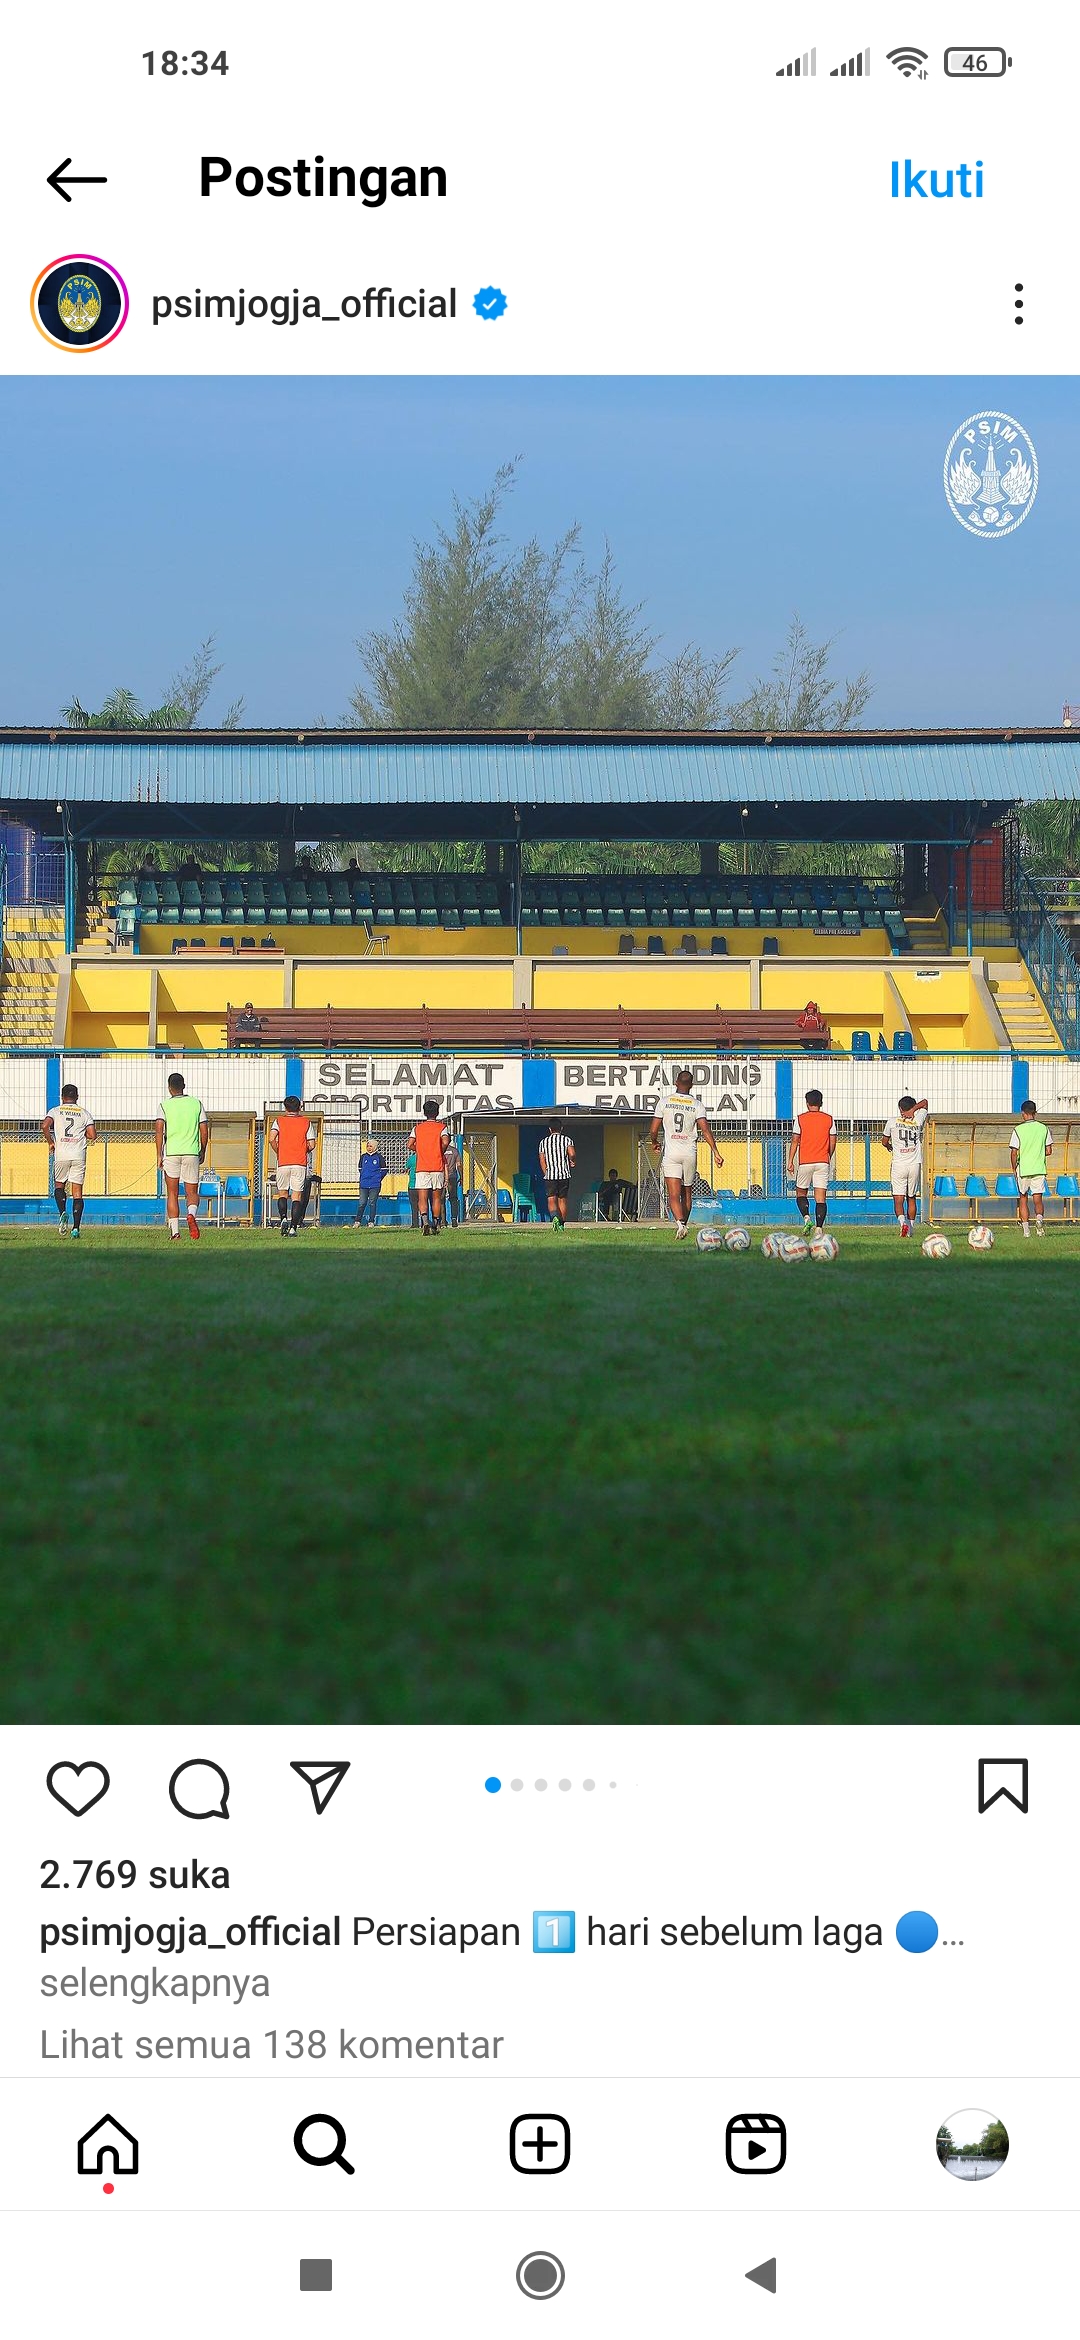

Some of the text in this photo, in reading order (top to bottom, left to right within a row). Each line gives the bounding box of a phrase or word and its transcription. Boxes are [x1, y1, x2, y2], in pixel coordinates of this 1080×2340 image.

[142, 50, 230, 76] 18:34
[962, 54, 988, 72] 46
[200, 154, 447, 209] Postingan
[891, 158, 984, 199] Ikuti
[67, 279, 92, 290] PSIM
[152, 286, 456, 326] psimjogja_official
[318, 1063, 504, 1087] SELAMAT
[563, 1064, 762, 1087] BERTANDING
[595, 1094, 756, 1112] FAIR LAY
[65, 1117, 74, 1137] 2
[674, 1112, 684, 1133] 9
[898, 1129, 918, 1148] 44
[39, 1858, 230, 1890] 2.769 suka
[40, 1914, 340, 1954] psimjogja_official
[353, 1916, 520, 1954] Persiapan
[588, 1915, 649, 1946] hari
[660, 1915, 803, 1947] sebelum
[814, 1915, 883, 1954] laga
[40, 1966, 270, 2005] selengkapnya
[41, 2028, 505, 2059] Lihat semua 138 komentar
